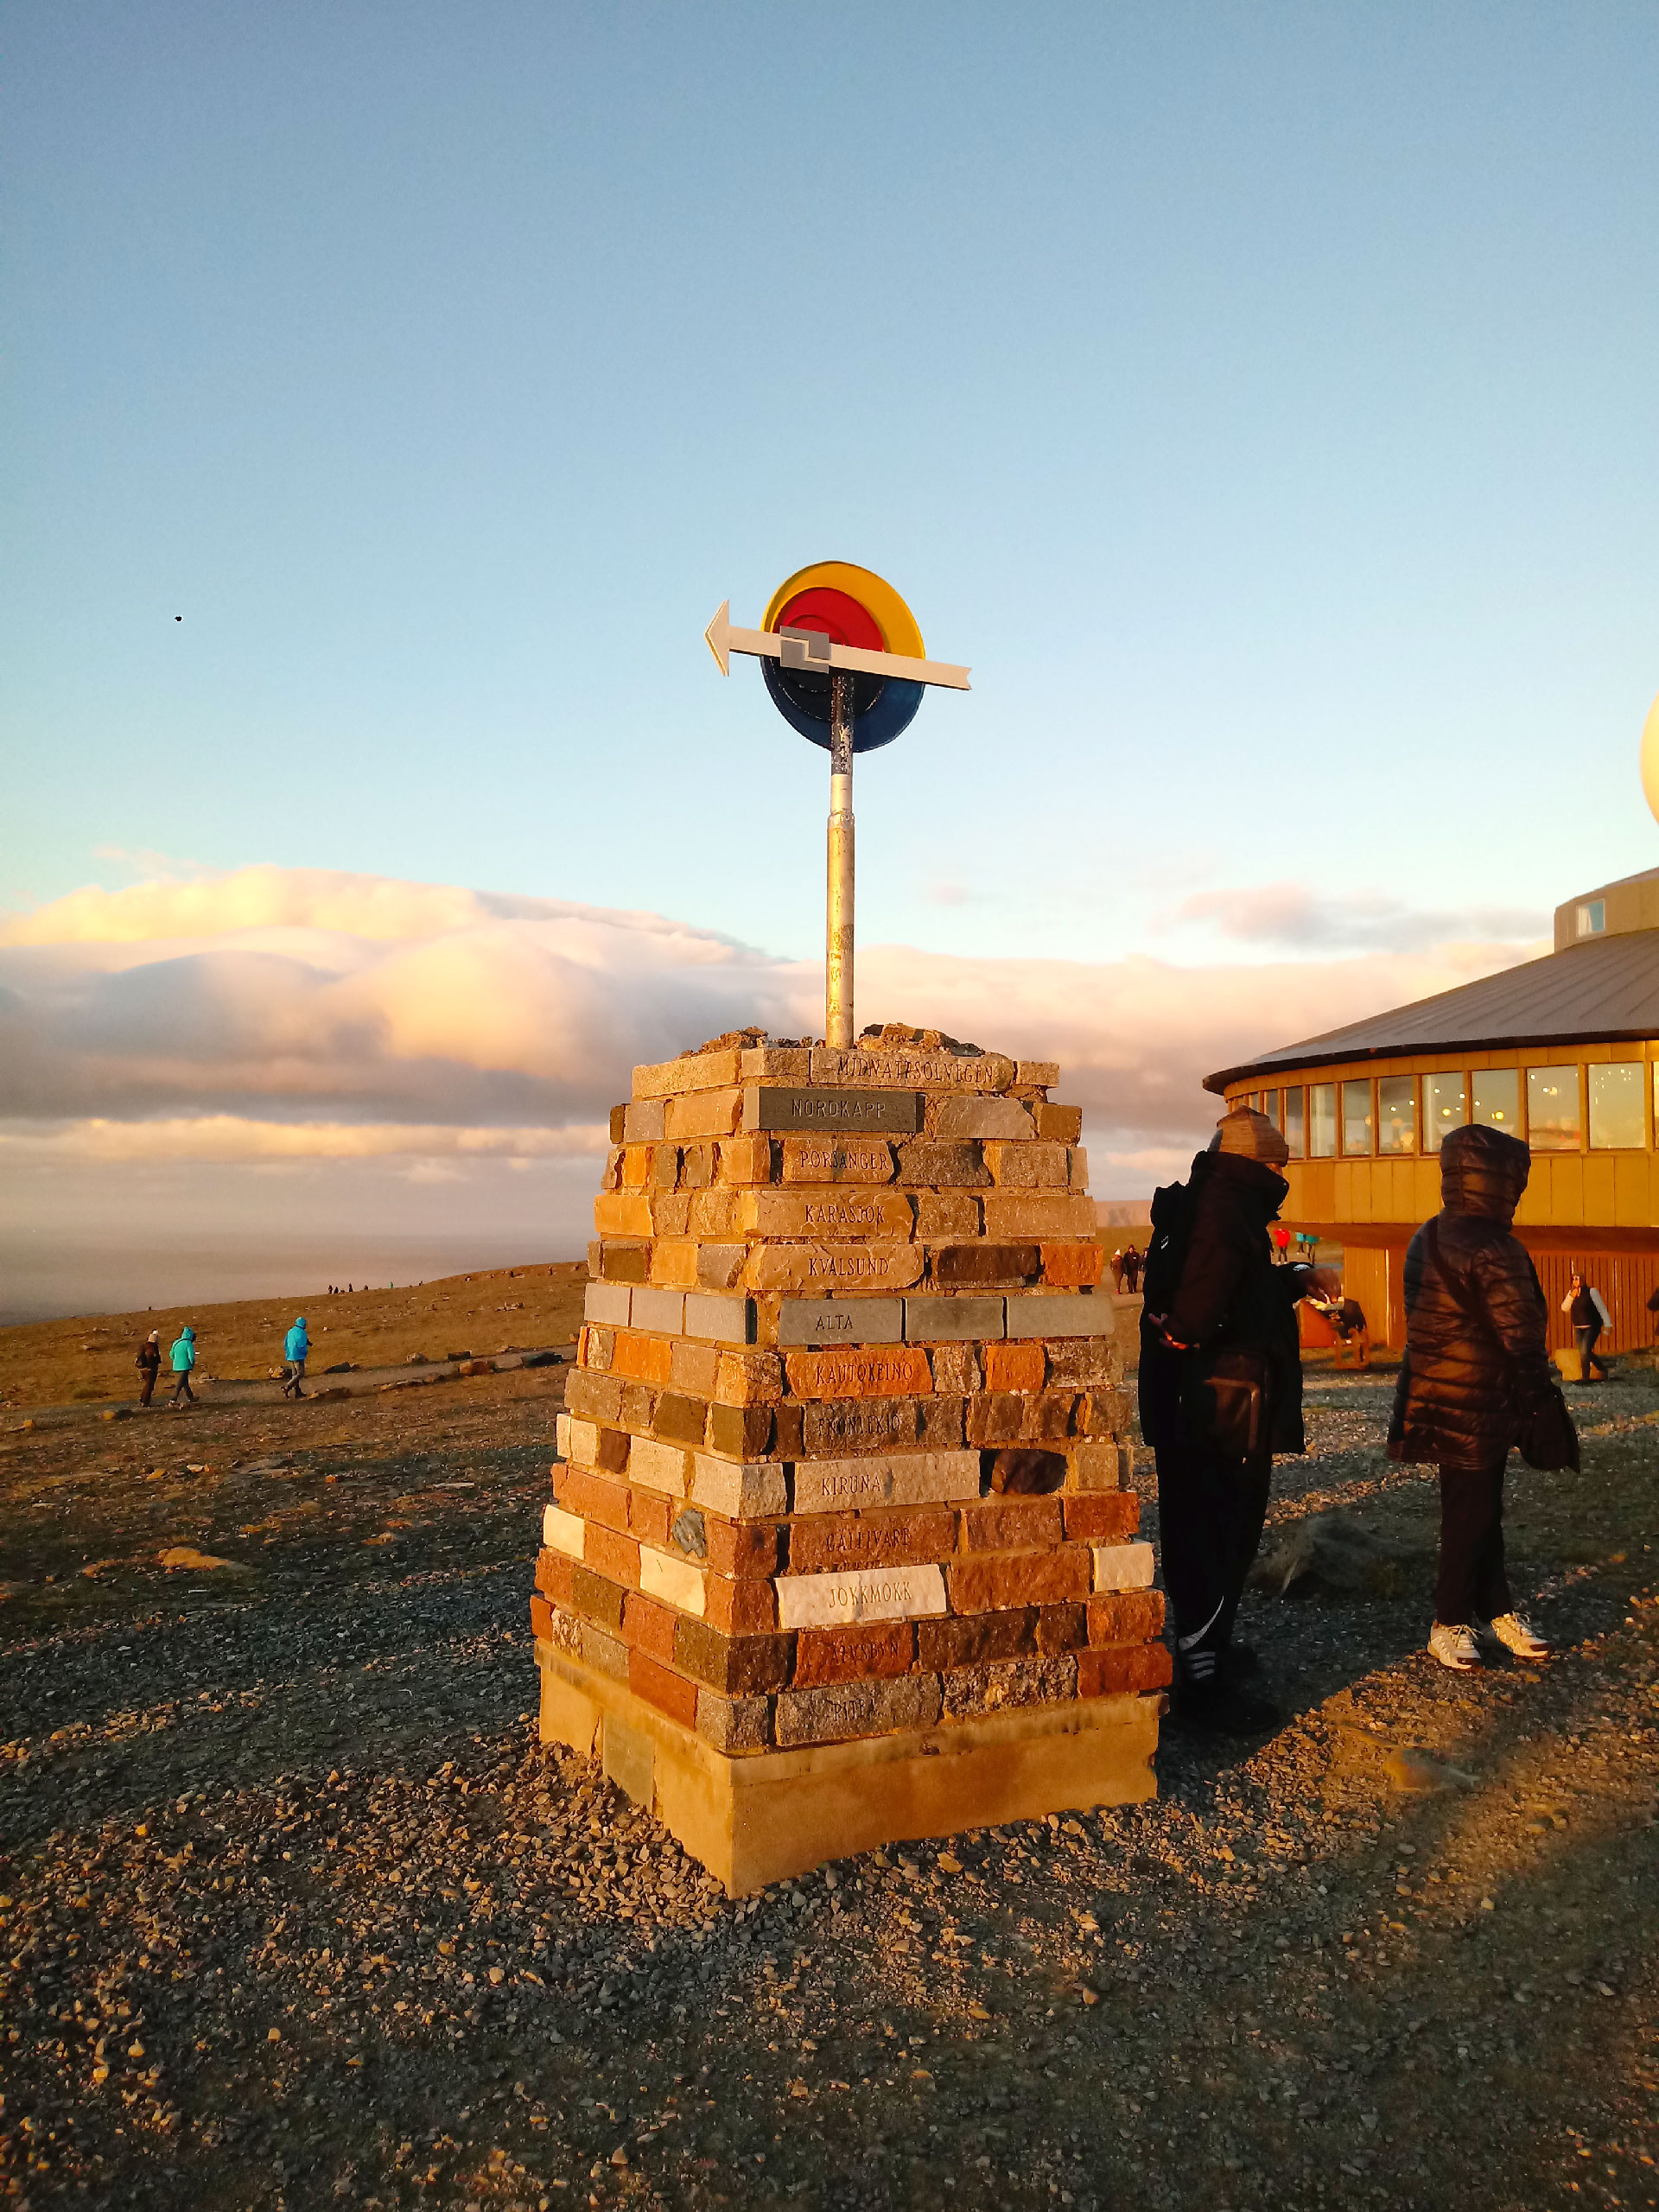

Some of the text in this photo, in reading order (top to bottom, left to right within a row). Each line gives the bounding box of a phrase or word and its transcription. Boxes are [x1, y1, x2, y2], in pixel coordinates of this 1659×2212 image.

[836, 1055, 994, 1083] MIDNATTSOLVEGEN
[791, 1098, 886, 1119] NORDKAPP
[800, 1150, 888, 1170] PORSANGER
[804, 1205, 885, 1224] KARASJOK
[808, 1257, 889, 1276] KVALSUND
[816, 1314, 853, 1331] ALTA
[816, 1362, 913, 1384] KAUTOKEINO
[822, 1474, 880, 1497] KIRUNA
[826, 1527, 912, 1553] GÄLLIVARE
[830, 1581, 912, 1608] JOKKMOKK
